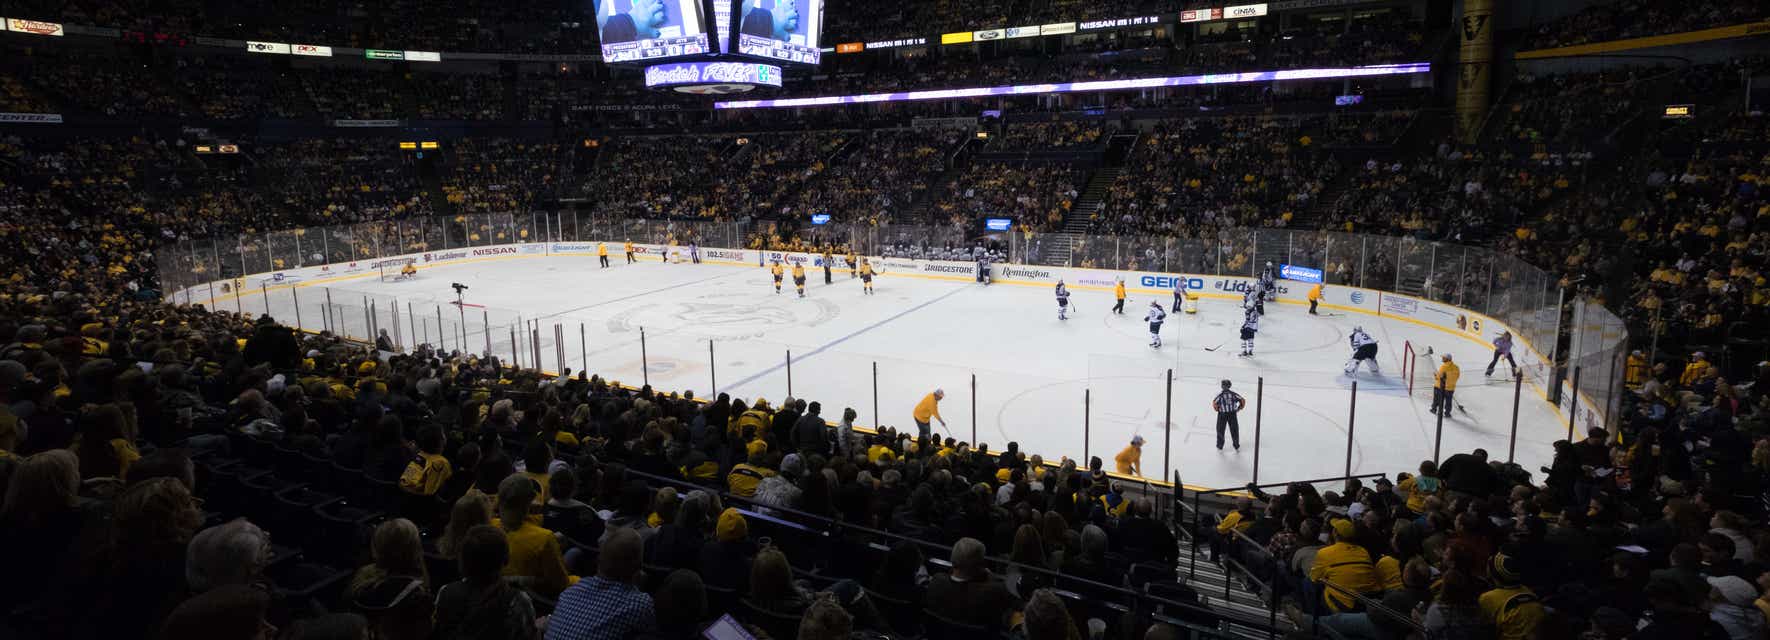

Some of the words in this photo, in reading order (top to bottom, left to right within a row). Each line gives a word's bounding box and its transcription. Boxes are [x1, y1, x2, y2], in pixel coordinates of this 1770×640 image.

[1080, 20, 1116, 29] NISSAN
[703, 62, 753, 82] FEVER
[473, 247, 516, 256] NISSAN
[924, 263, 975, 274] BRIDGESTONE
[1002, 266, 1049, 279] Remington
[1141, 275, 1204, 290] GEICO
